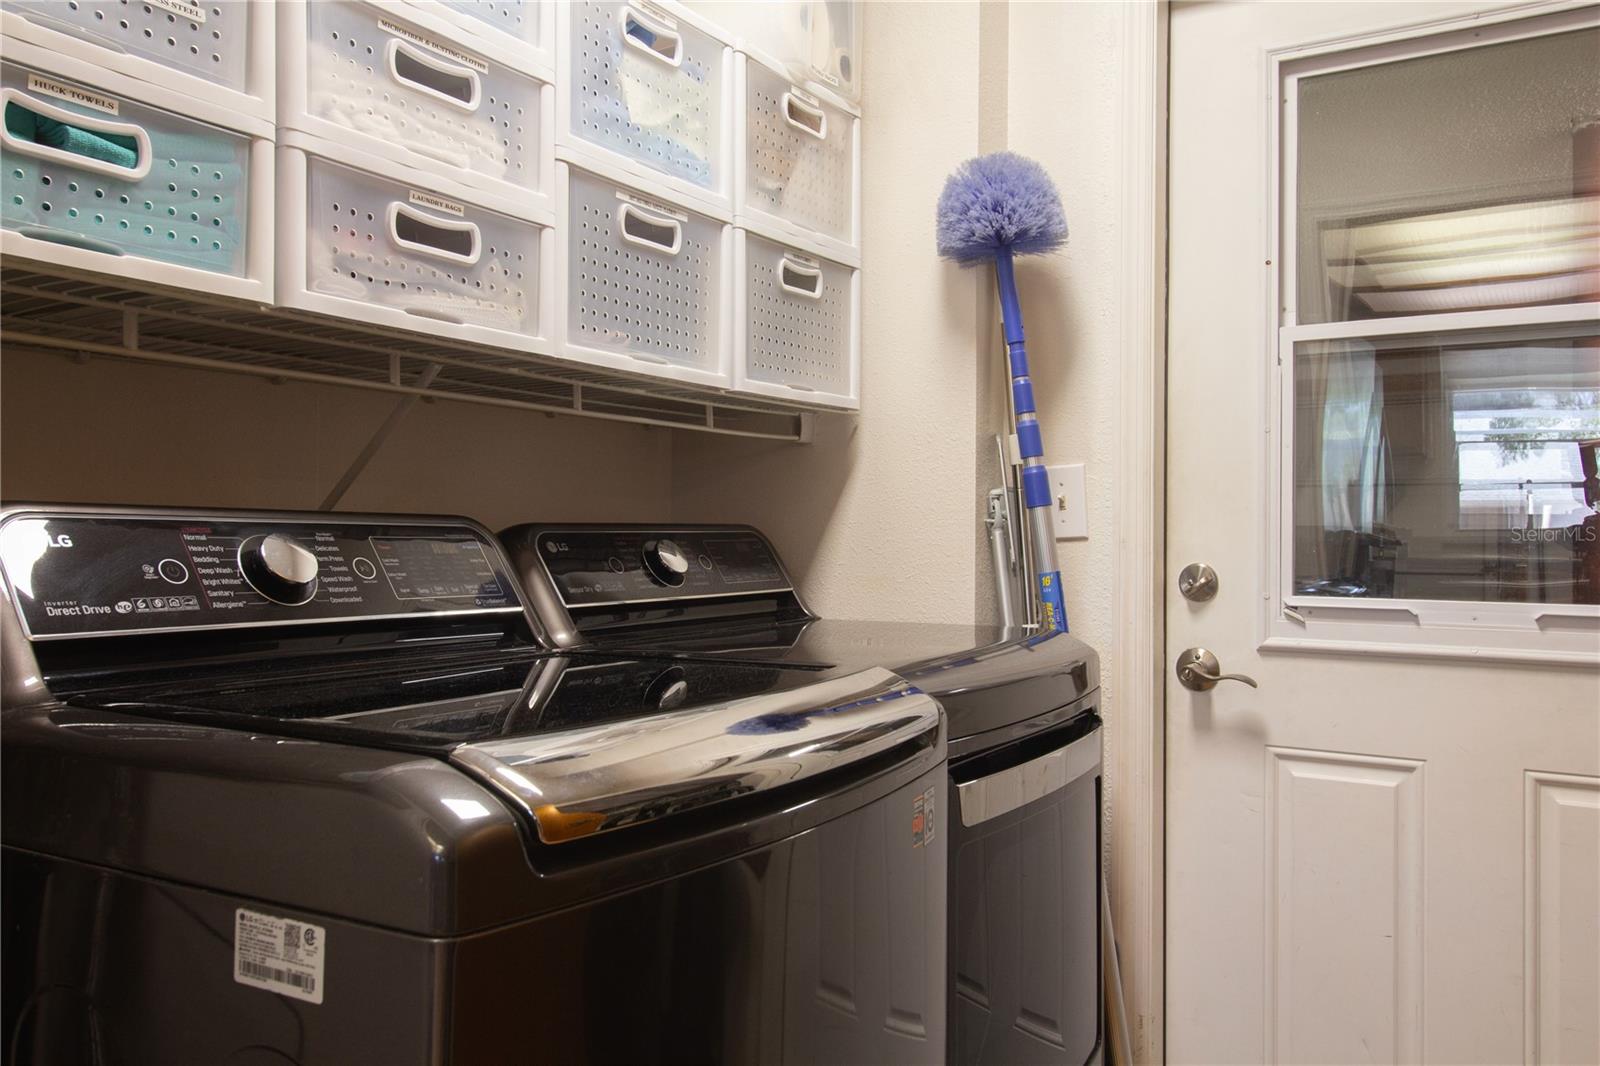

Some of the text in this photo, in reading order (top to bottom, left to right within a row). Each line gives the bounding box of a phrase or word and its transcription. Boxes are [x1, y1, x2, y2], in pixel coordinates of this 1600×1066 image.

[171, 2, 202, 18] STEEL
[381, 19, 424, 43] MICROFIBER
[431, 42, 460, 59] DUSTING
[461, 55, 486, 70] CLOTHS
[34, 80, 115, 110] HUCK TOWELS
[412, 193, 462, 213] LAUNDRY BAGS
[48, 534, 73, 548] LG
[556, 543, 569, 551] LG
[209, 545, 224, 553] Duty
[192, 556, 220, 564] Bedding
[197, 567, 214, 575] Deep
[202, 578, 220, 586] Bright
[45, 604, 112, 617] Direct Drive
